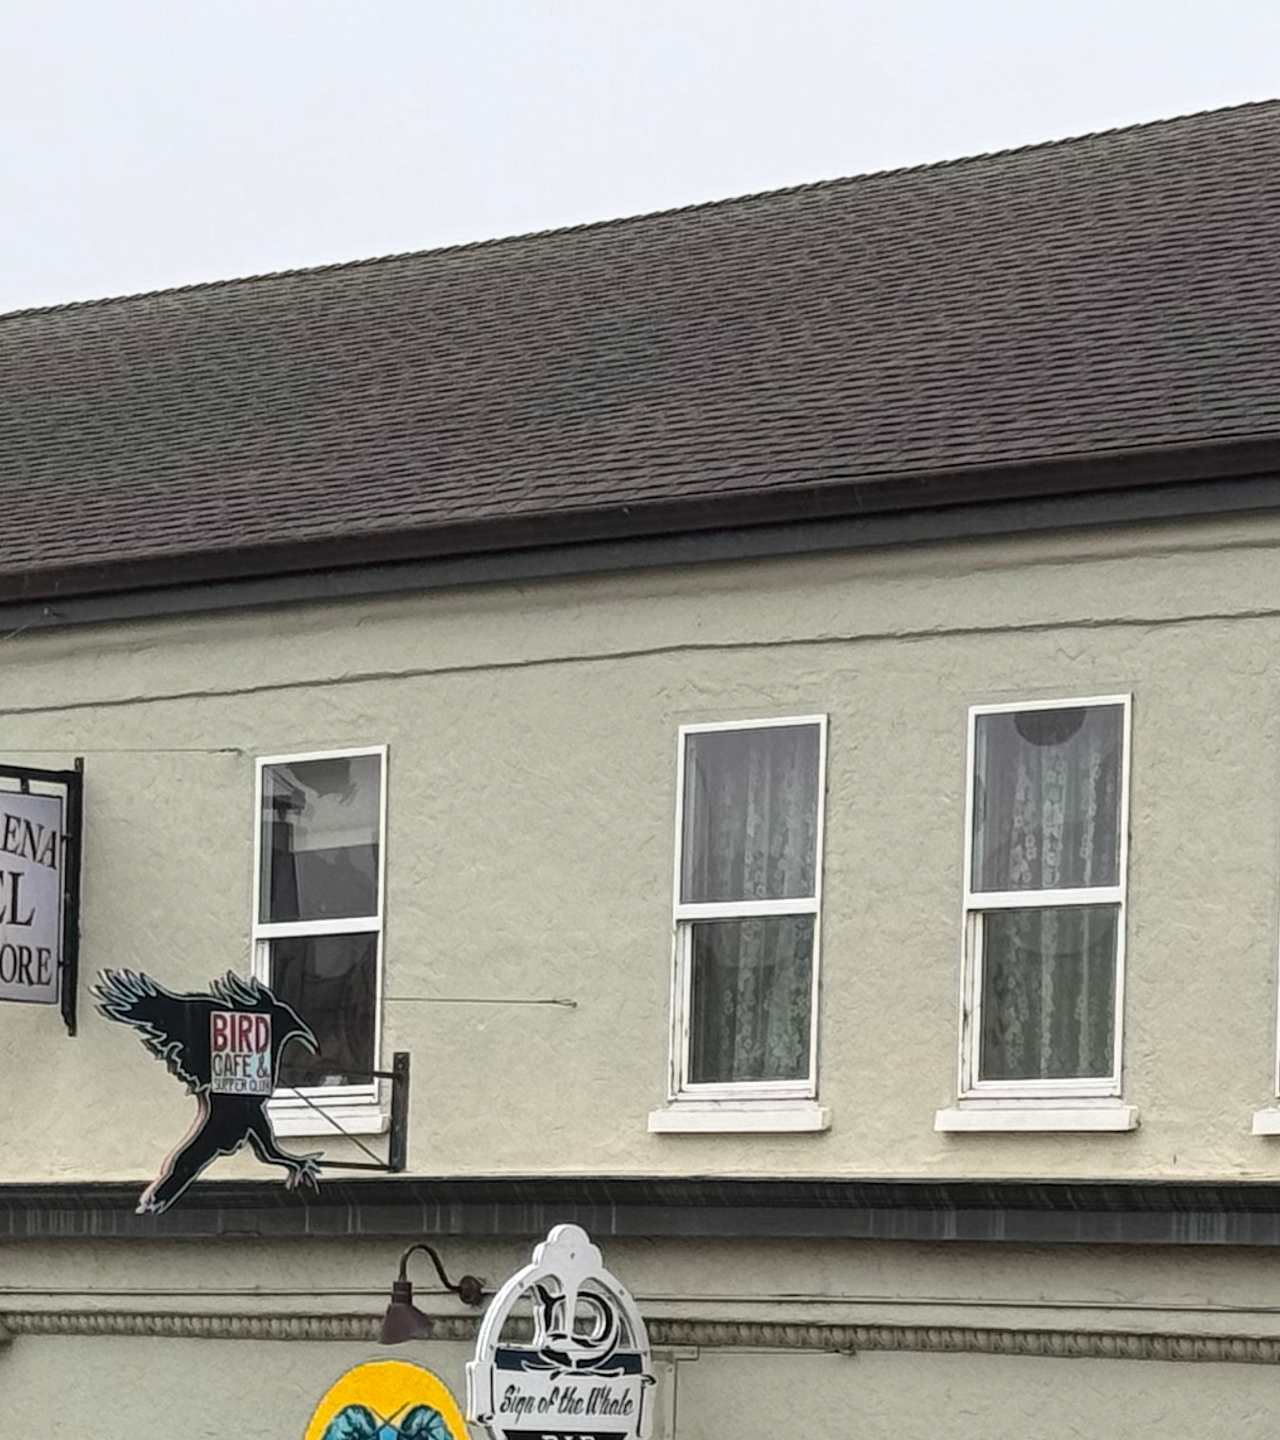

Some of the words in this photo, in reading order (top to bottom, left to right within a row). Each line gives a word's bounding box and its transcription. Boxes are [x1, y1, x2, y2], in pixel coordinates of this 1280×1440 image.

[213, 1014, 270, 1055] BIRD
[212, 1053, 252, 1078] CAFE
[256, 1053, 271, 1079] &
[499, 1384, 536, 1424] Sign
[537, 1386, 561, 1415] of
[558, 1386, 585, 1416] the
[585, 1386, 635, 1417] Whale
